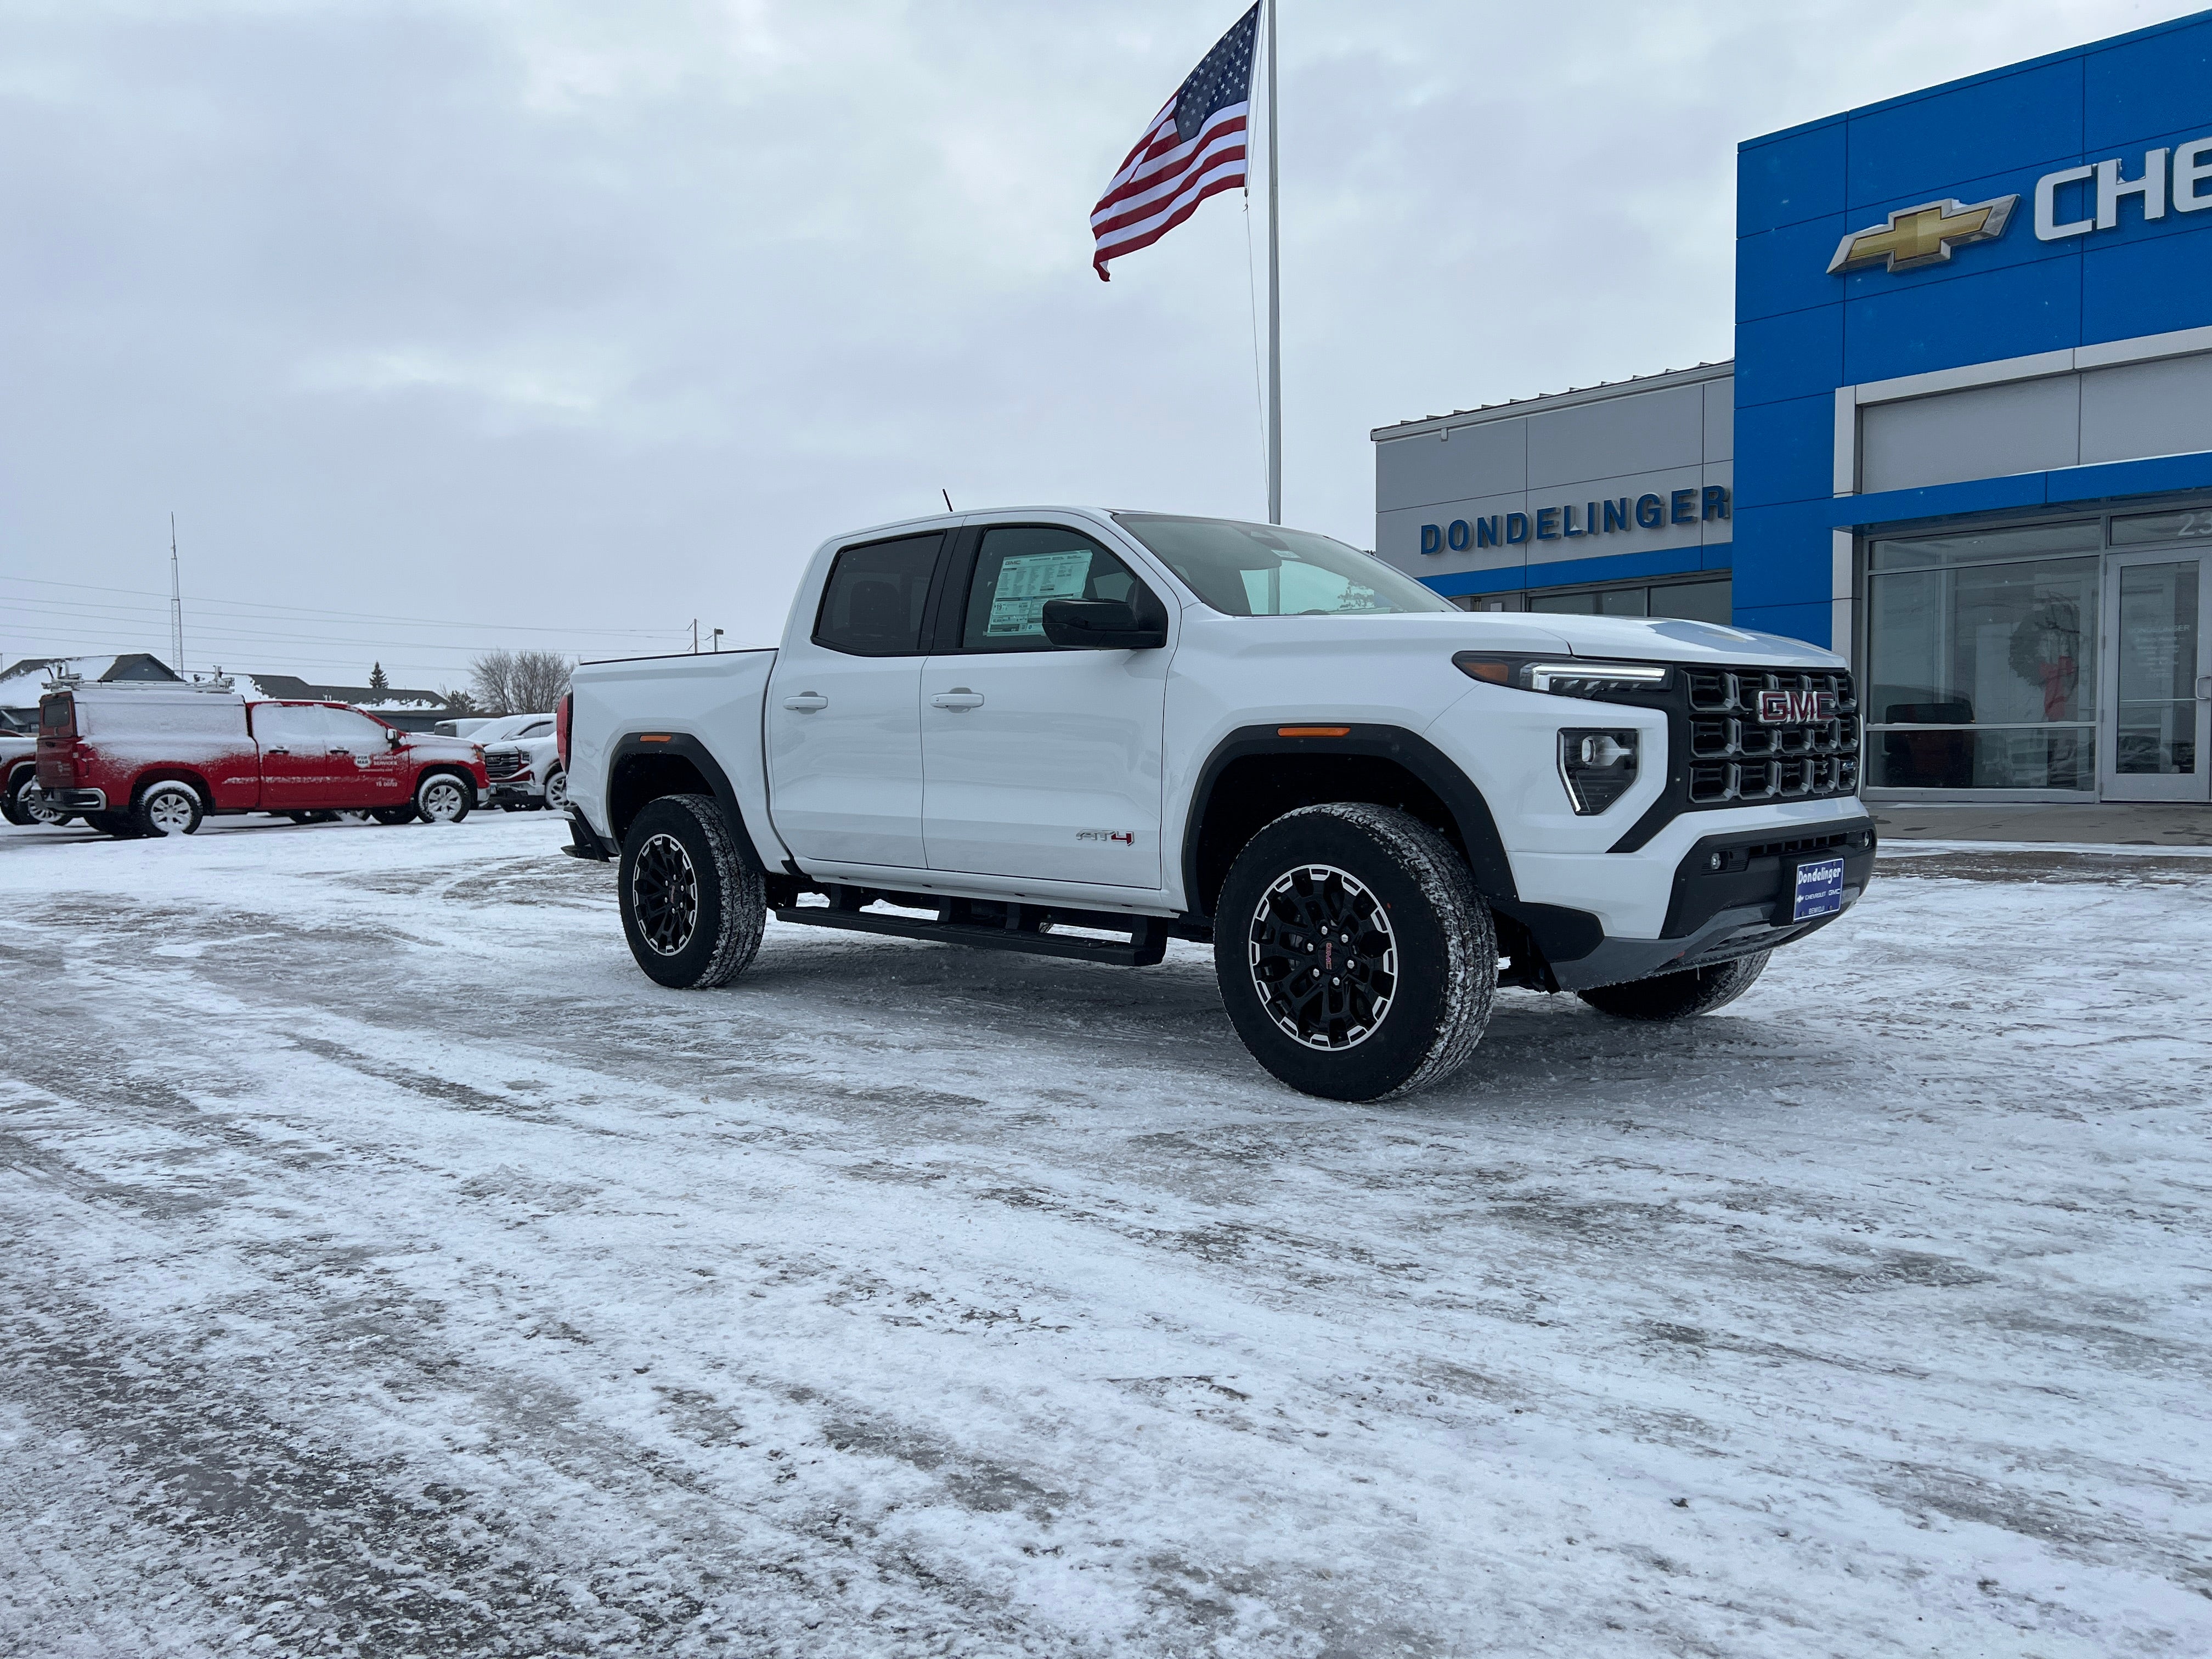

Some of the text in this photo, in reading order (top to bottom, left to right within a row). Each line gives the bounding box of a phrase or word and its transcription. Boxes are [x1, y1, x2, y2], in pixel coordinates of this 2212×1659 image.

[1421, 484, 1730, 555] DONDELINGER
[1758, 691, 1836, 724] GMC
[1075, 829, 1135, 846] AT4
[1798, 867, 1841, 884] Dondelinger
[1805, 891, 1826, 900] CHEVROLET
